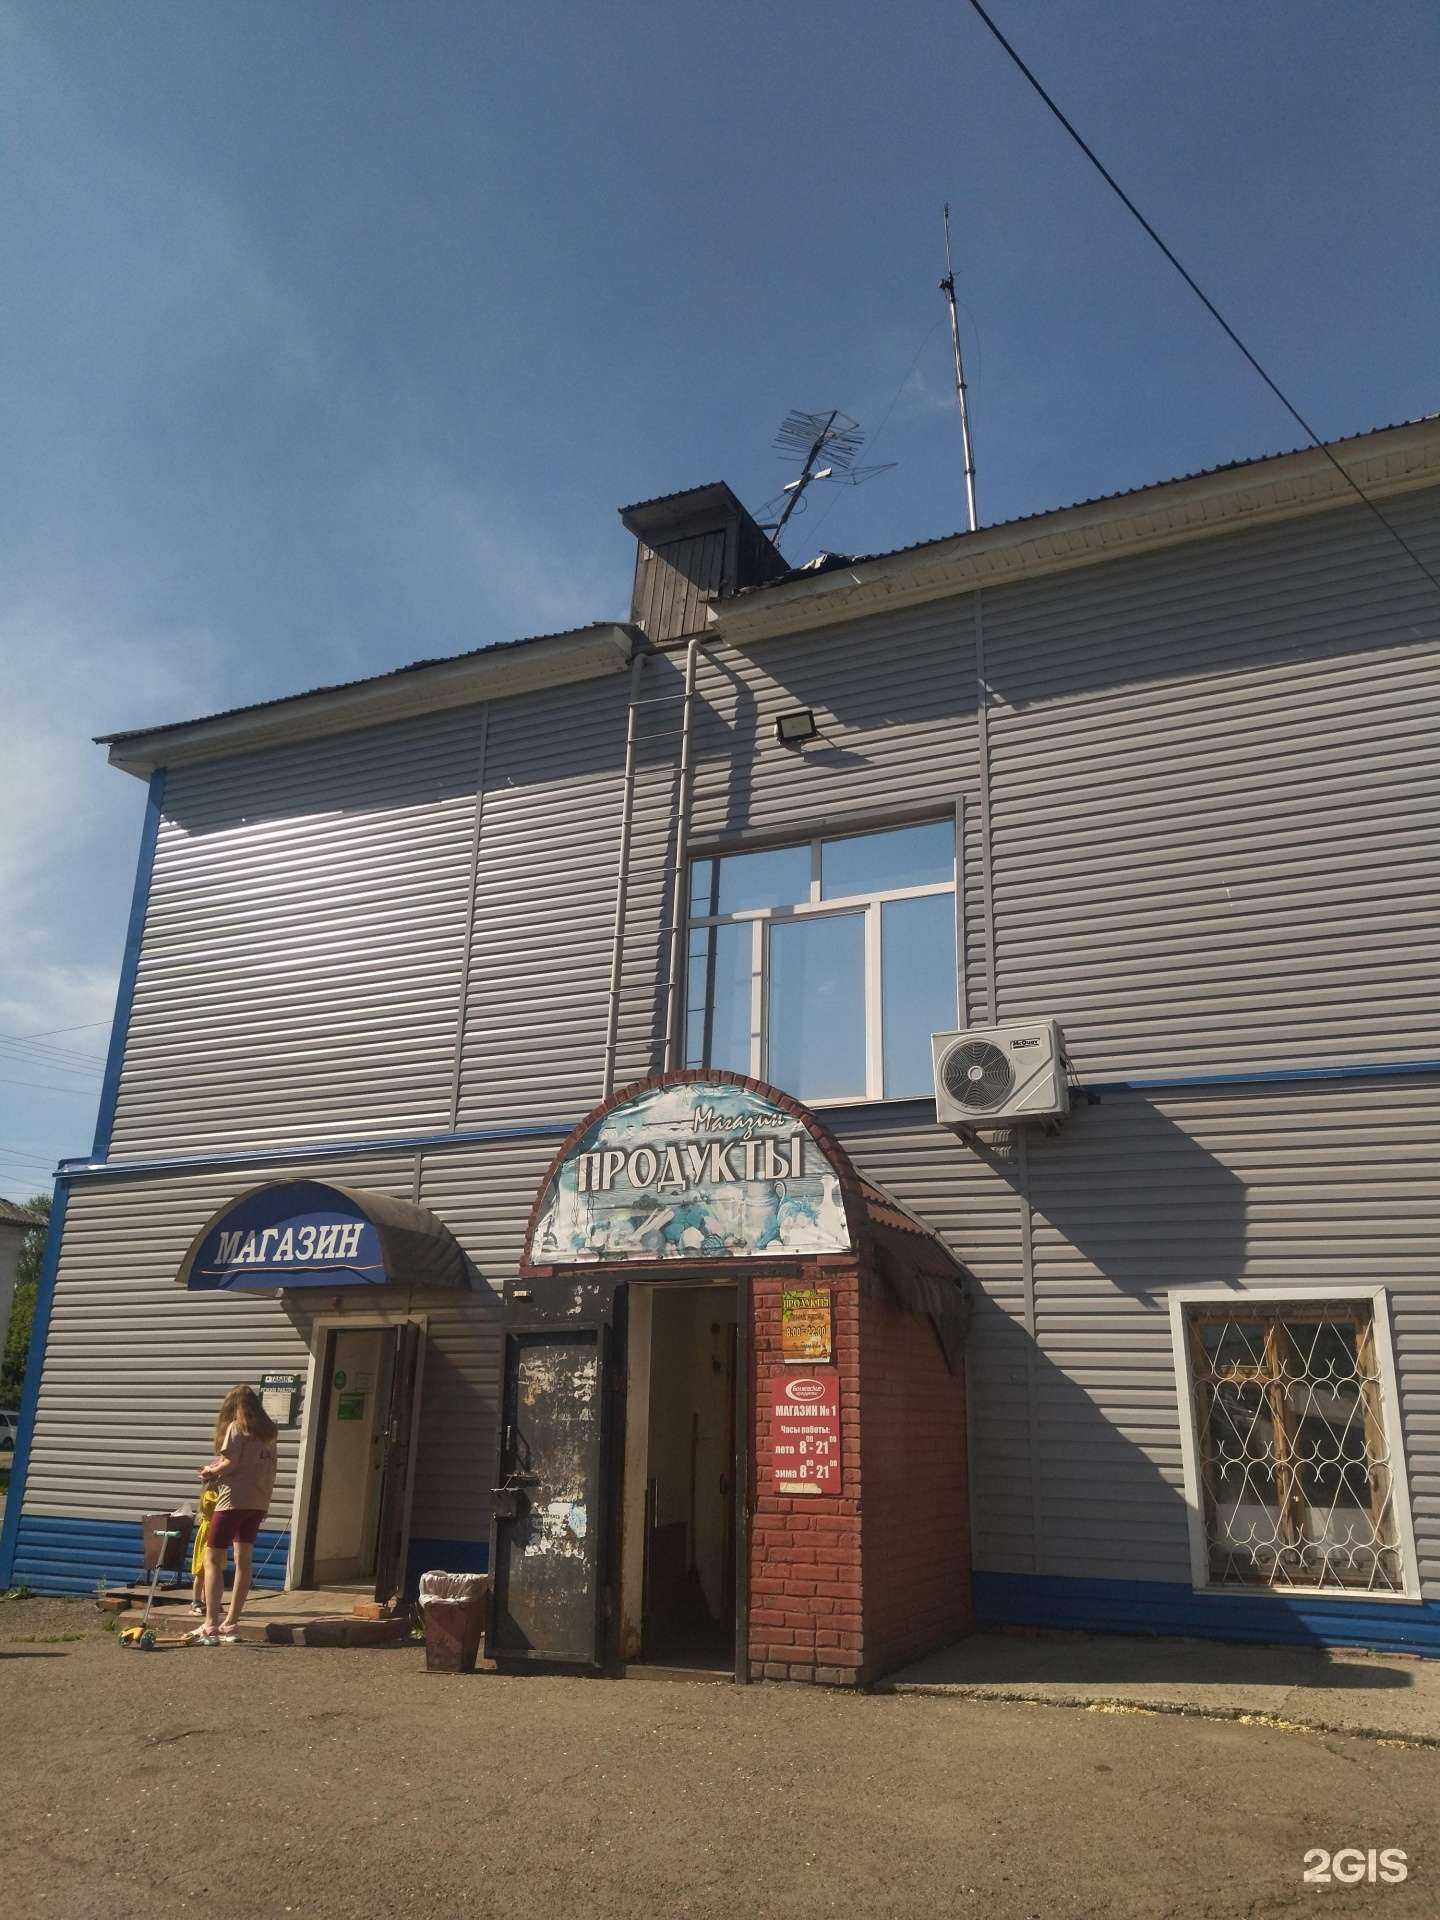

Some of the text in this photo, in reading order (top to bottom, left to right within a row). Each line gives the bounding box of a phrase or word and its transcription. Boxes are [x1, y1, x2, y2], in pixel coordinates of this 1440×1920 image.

[692, 1105, 785, 1141] Магазин
[577, 1136, 805, 1193] ПРОДУКТЫ
[214, 1223, 365, 1264] МАГАЗИН
[783, 1298, 830, 1309] ПРОДУКТЫ
[775, 1404, 818, 1417] МАГАЗИН
[781, 1425, 831, 1434] Часы работы:
[775, 1445, 795, 1455] лето
[775, 1469, 797, 1478] зима
